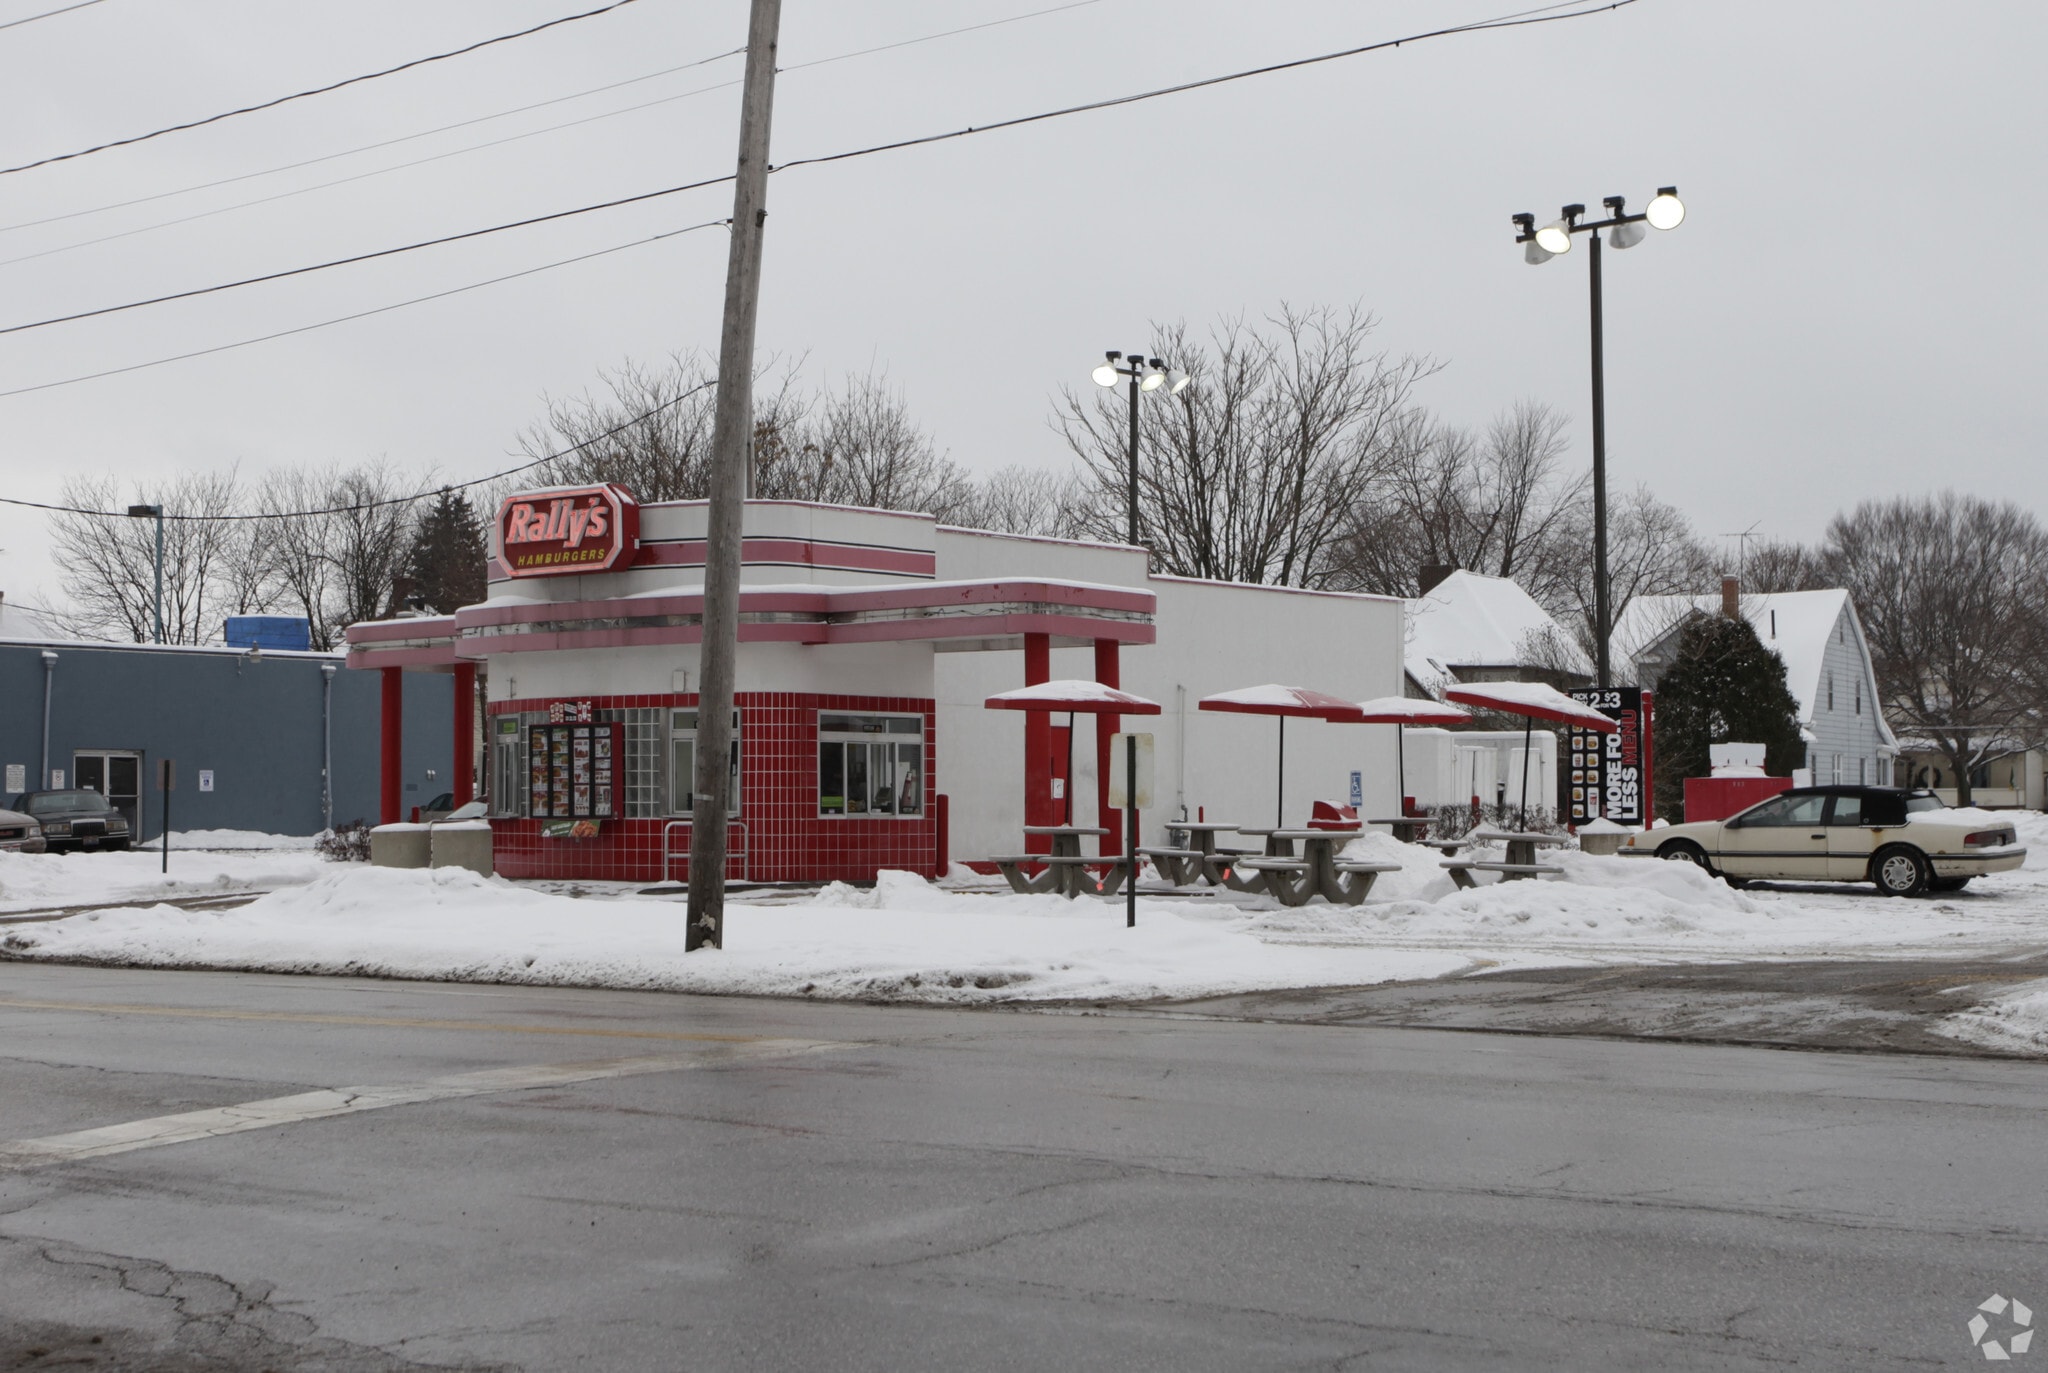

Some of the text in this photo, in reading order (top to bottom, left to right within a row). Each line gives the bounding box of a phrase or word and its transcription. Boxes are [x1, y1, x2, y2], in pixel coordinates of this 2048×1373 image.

[505, 497, 609, 548] Rally's
[518, 549, 606, 566] HAMBURGERS
[1590, 692, 1601, 709] 2
[1606, 718, 1622, 819] MORE FO
[1621, 709, 1639, 819] LESS MENU
